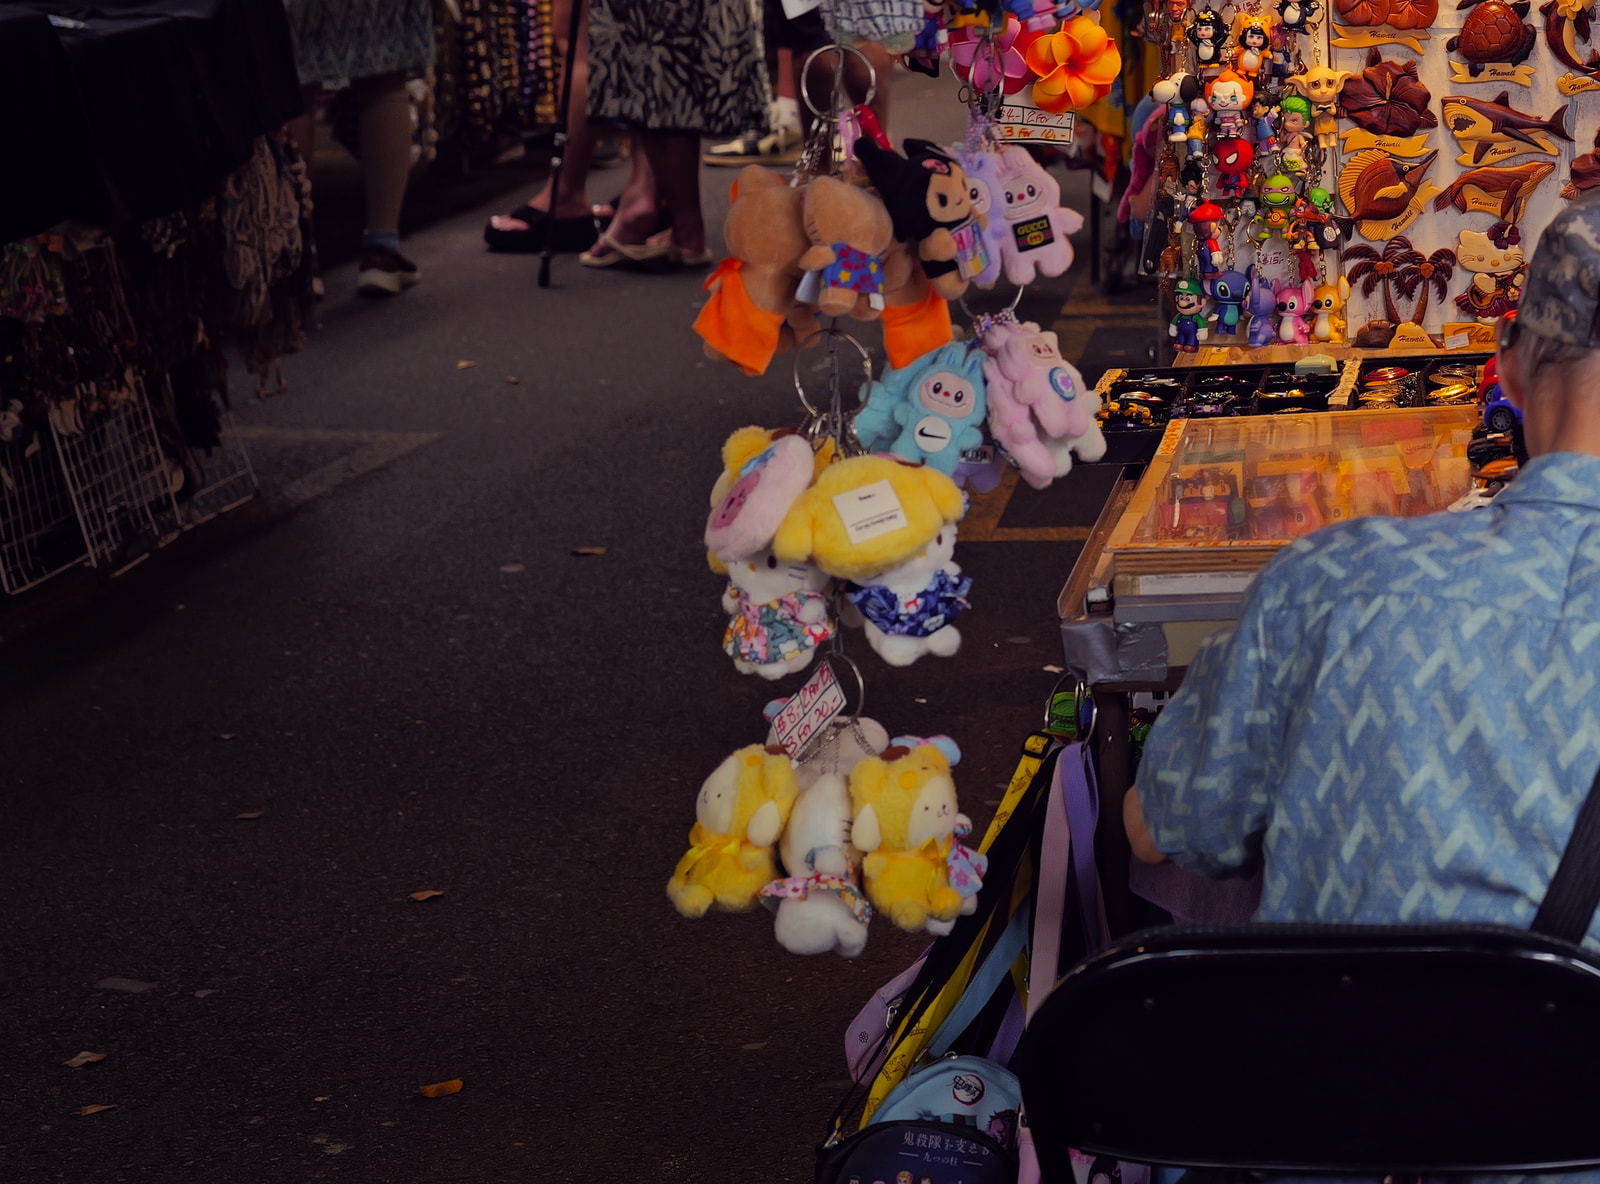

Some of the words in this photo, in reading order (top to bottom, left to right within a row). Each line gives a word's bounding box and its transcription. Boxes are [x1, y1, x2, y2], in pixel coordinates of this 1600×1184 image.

[1489, 68, 1515, 77] Hawaii
[1004, 126, 1014, 137] 3
[1491, 147, 1517, 157] Hawaii
[1471, 198, 1498, 208] Hawaii
[1017, 219, 1049, 235] GUCCI
[1398, 334, 1425, 344] Hawaii
